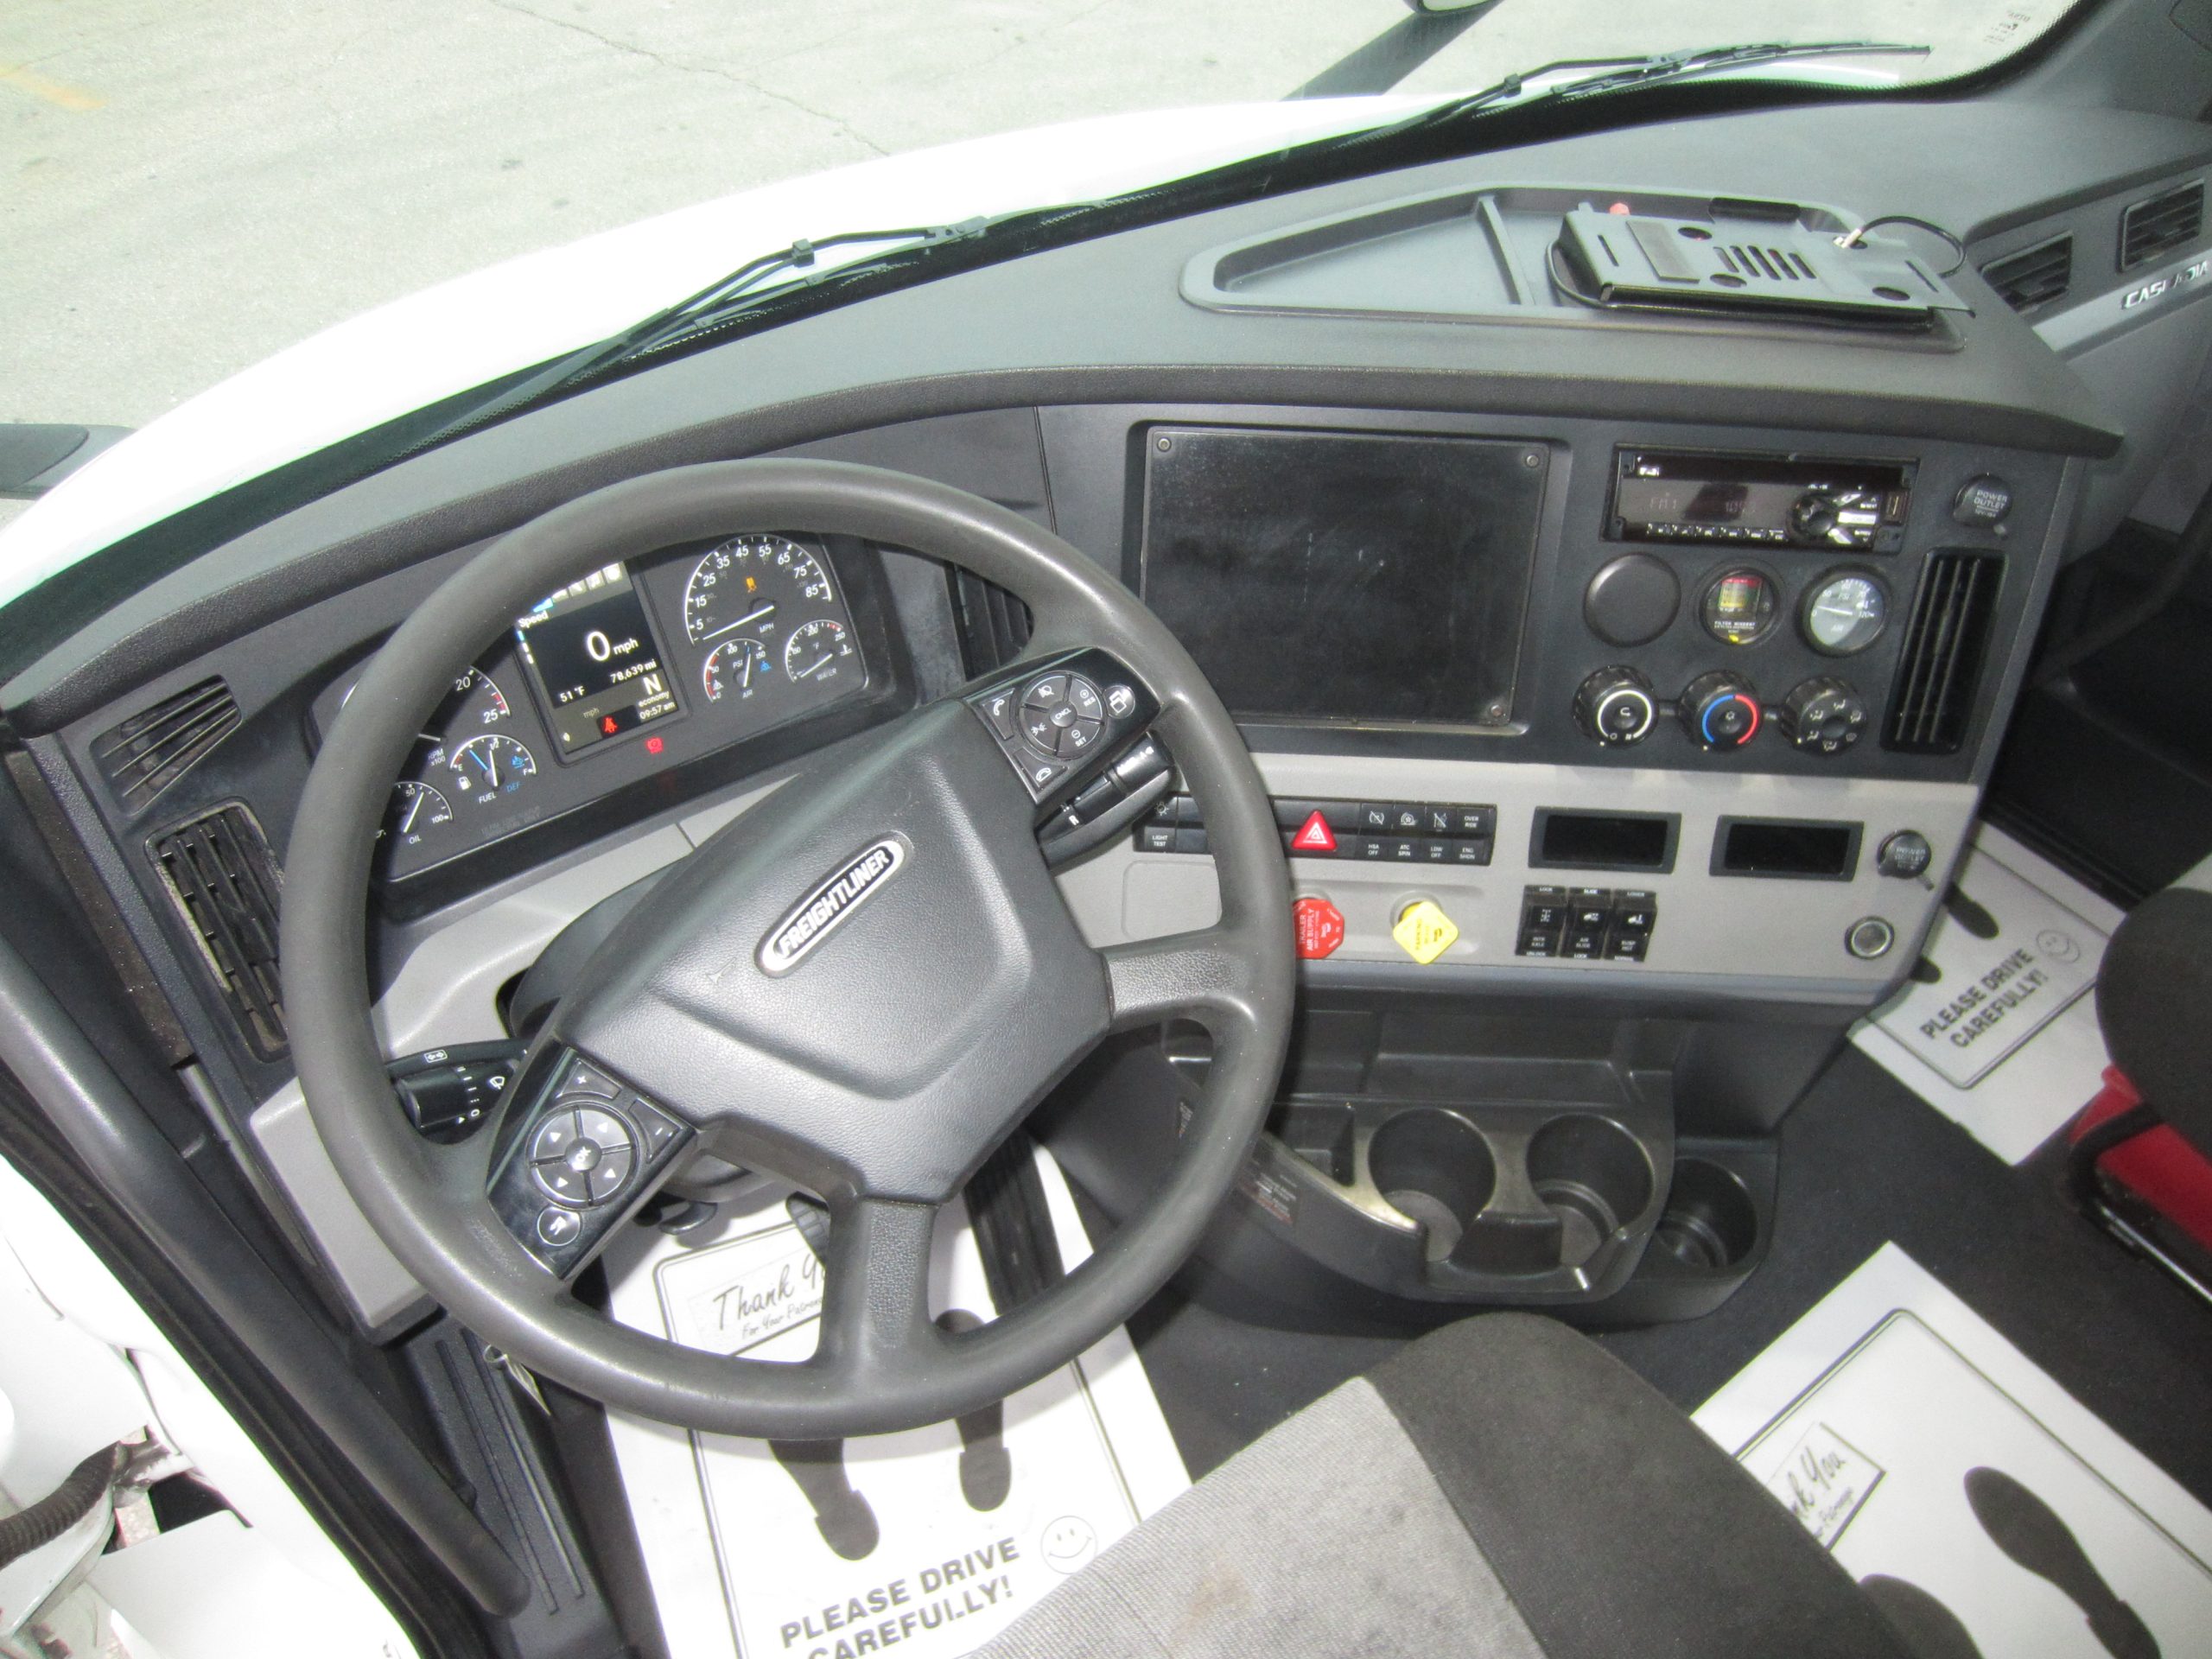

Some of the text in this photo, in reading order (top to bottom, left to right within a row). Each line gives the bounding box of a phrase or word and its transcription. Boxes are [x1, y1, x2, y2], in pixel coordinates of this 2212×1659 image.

[1974, 497, 2005, 509] OUTLET
[735, 544, 749, 558] 45
[759, 544, 772, 557] 55
[716, 556, 730, 569] 35
[778, 552, 791, 566] 65
[793, 565, 807, 579] 75
[702, 573, 716, 587] 25
[805, 584, 818, 598] 85
[695, 594, 707, 607] 15
[518, 610, 549, 629] Speed
[696, 619, 704, 631] 5
[759, 623, 774, 633] MPH
[586, 631, 639, 661] 0 mph
[727, 646, 737, 656] 100
[610, 658, 657, 683] 78,639 mi
[733, 660, 744, 669] PSI
[455, 677, 471, 691] 20
[643, 673, 662, 696] N
[560, 690, 574, 703] 51
[638, 690, 670, 708] economy
[742, 690, 753, 700] AIR
[483, 709, 499, 723] 25
[639, 702, 676, 720] 09:57 am
[1075, 736, 1087, 747] SET
[428, 748, 444, 760] RPM
[405, 788, 416, 797] 50
[506, 781, 521, 794] DEF
[478, 791, 497, 804] FUEL
[431, 815, 443, 824] 100
[409, 835, 422, 844] OIL
[779, 849, 890, 958] FREIGHTLINER
[1919, 948, 2035, 1039] PLEASE DRIVE
[1949, 968, 2049, 1048] CAREFULLY!
[575, 1146, 591, 1162] OK
[713, 1264, 795, 1331] Thank
[1800, 1446, 1847, 1491] You
[779, 1536, 1020, 1649] PLEASE DRIVE
